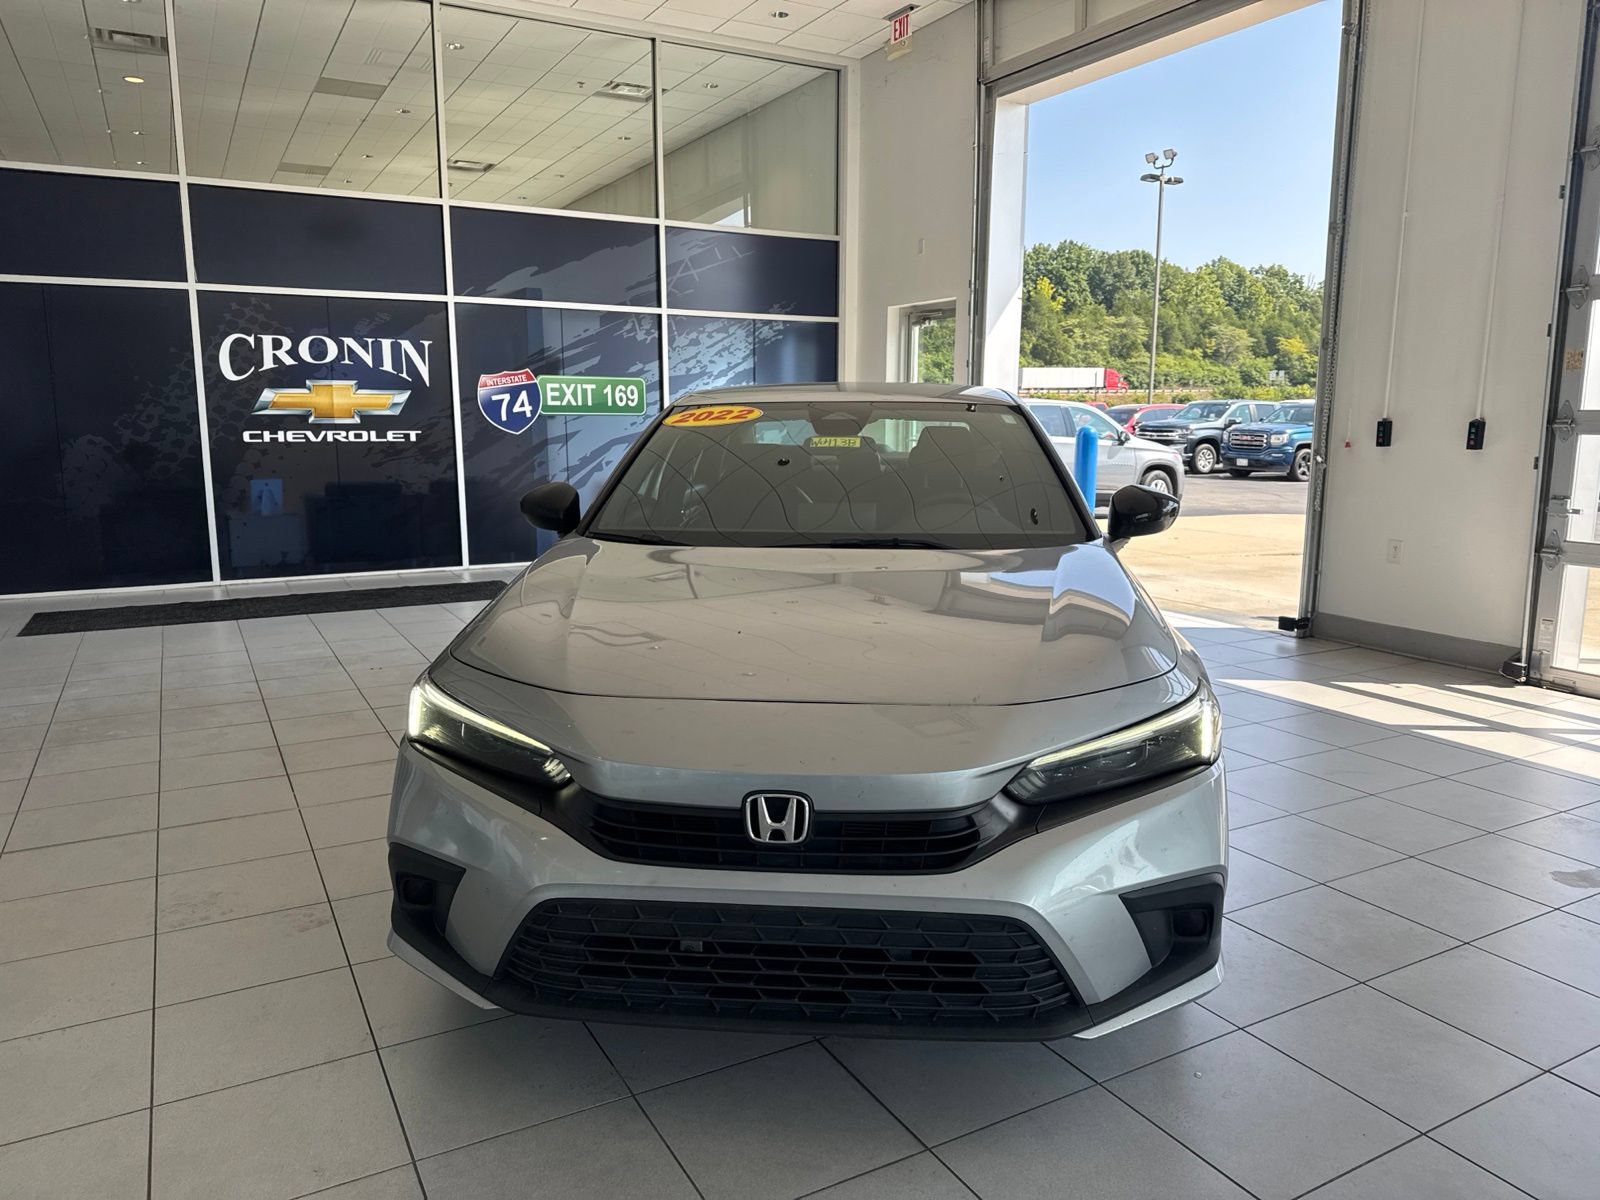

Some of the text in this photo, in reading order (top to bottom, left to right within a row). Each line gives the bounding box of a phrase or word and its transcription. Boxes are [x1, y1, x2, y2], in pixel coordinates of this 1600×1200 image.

[893, 13, 910, 42] EXIT
[217, 332, 434, 388] CRONIN
[485, 373, 529, 386] INTERSTATE
[490, 389, 534, 423] 74
[546, 383, 639, 408] EXIT 169
[669, 408, 756, 425] 2022
[242, 430, 422, 443] CHEVROLET
